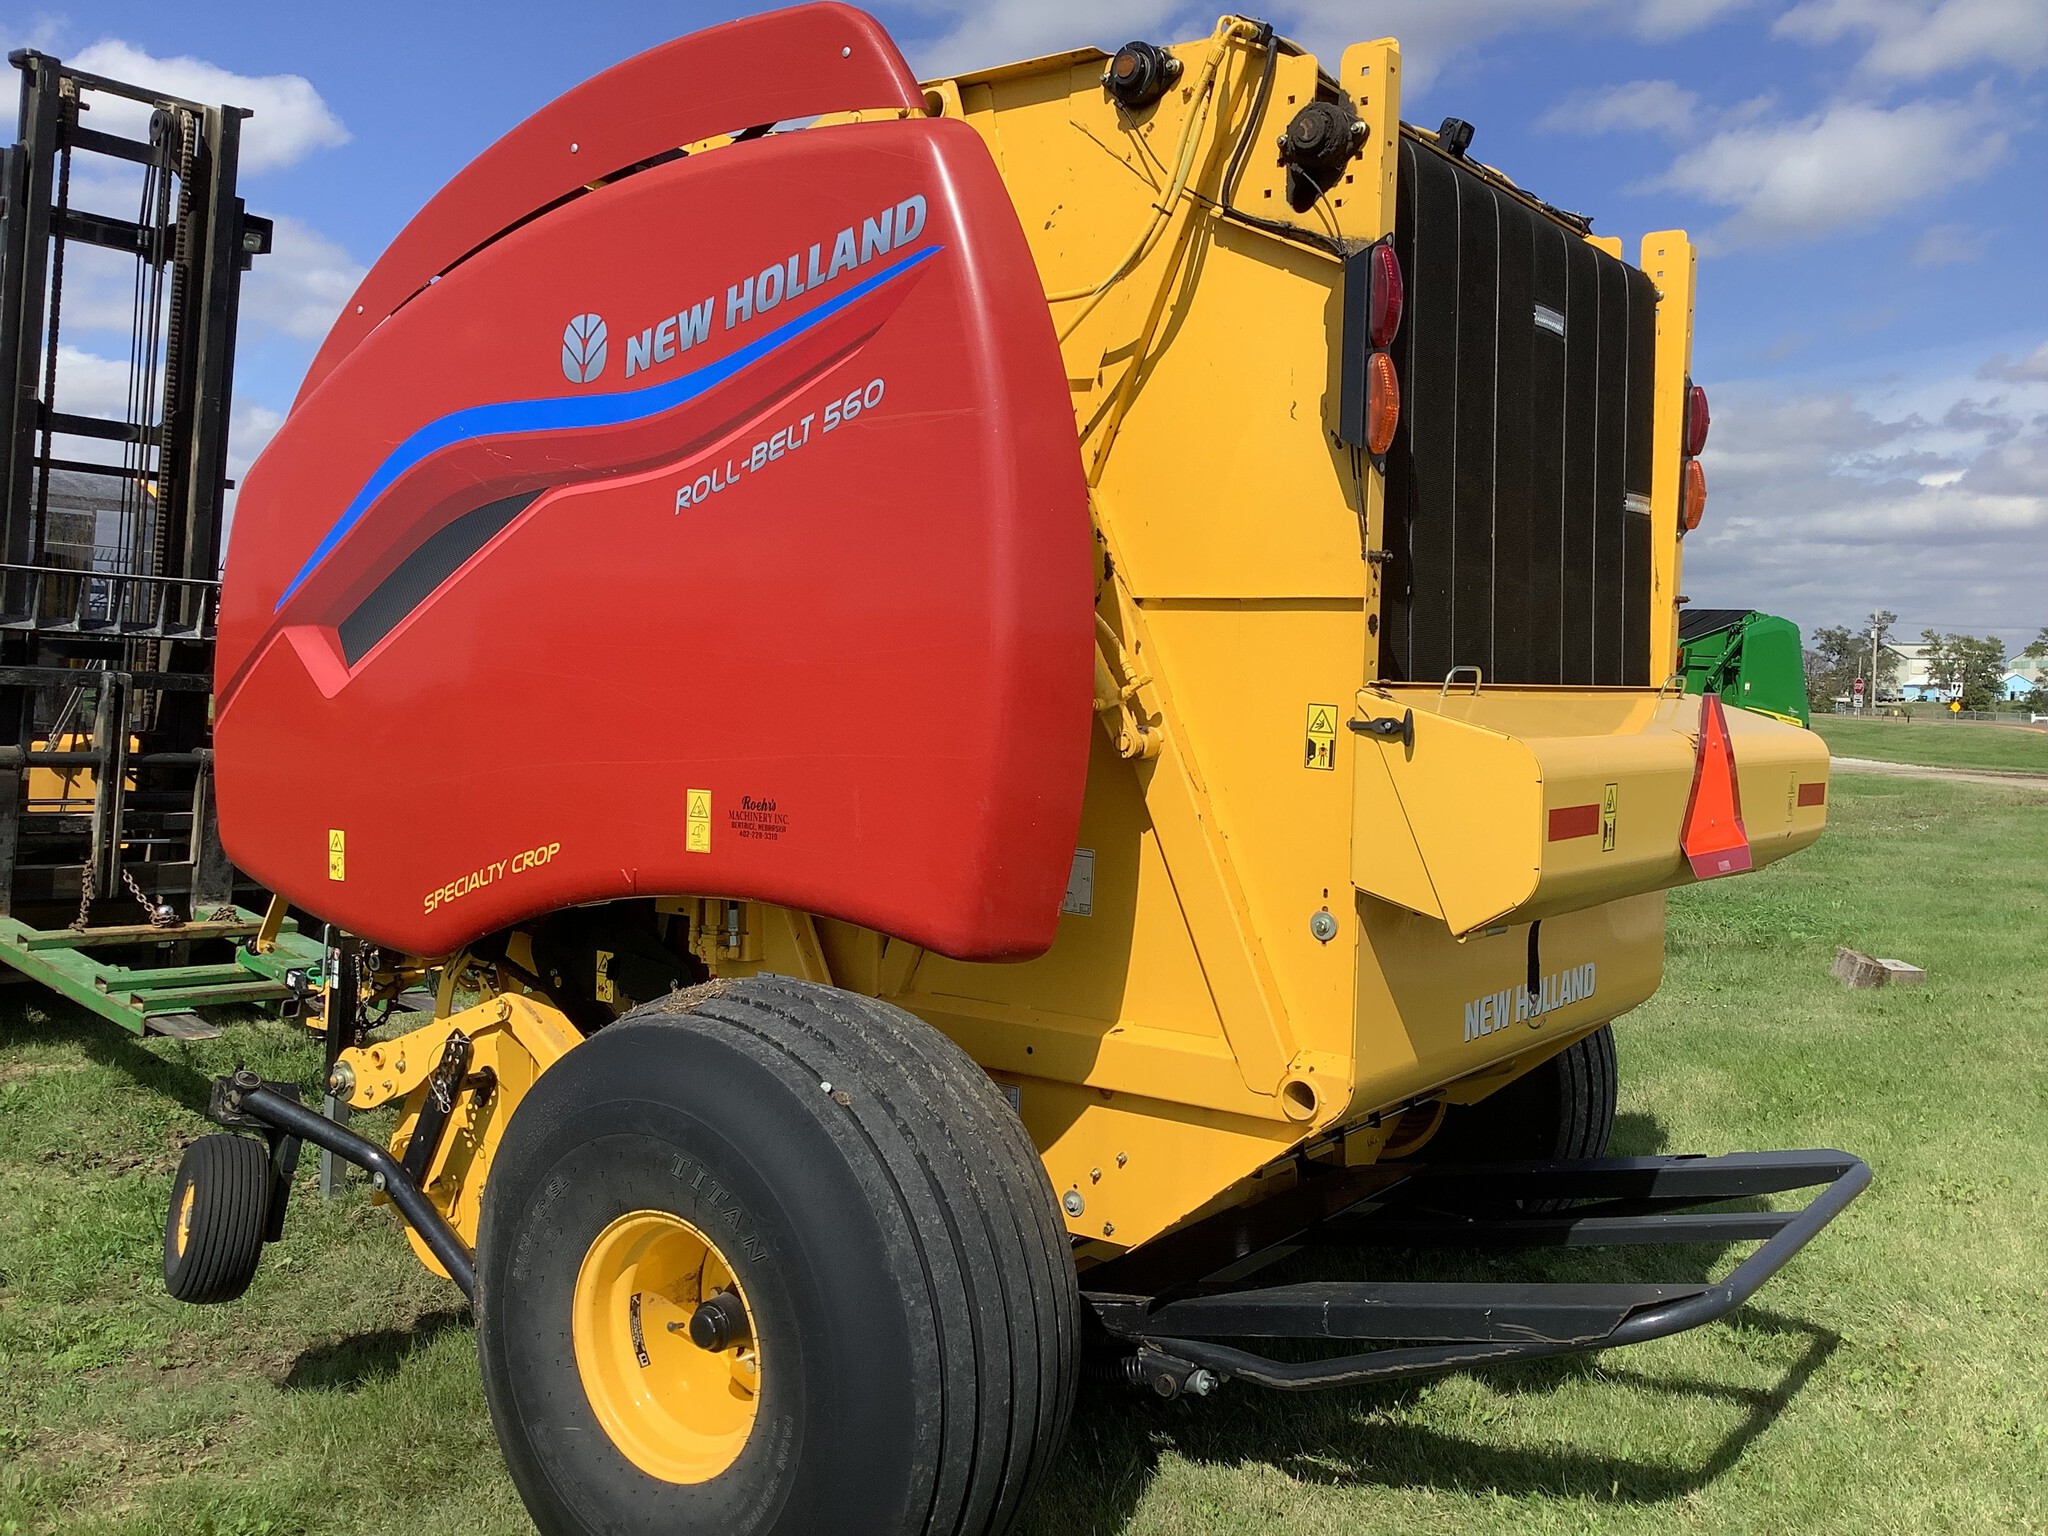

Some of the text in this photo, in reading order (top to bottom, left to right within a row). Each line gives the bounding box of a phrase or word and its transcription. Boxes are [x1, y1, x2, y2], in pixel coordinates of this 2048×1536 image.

[624, 193, 928, 379] NEW HOLLAND
[674, 378, 885, 516] ROLL-BELT 560
[728, 809, 790, 825] MACHINERY INC.
[424, 842, 561, 915] SPECIALTY CROP
[1464, 988, 1513, 1043] NEW
[670, 1153, 769, 1263] TITAN
